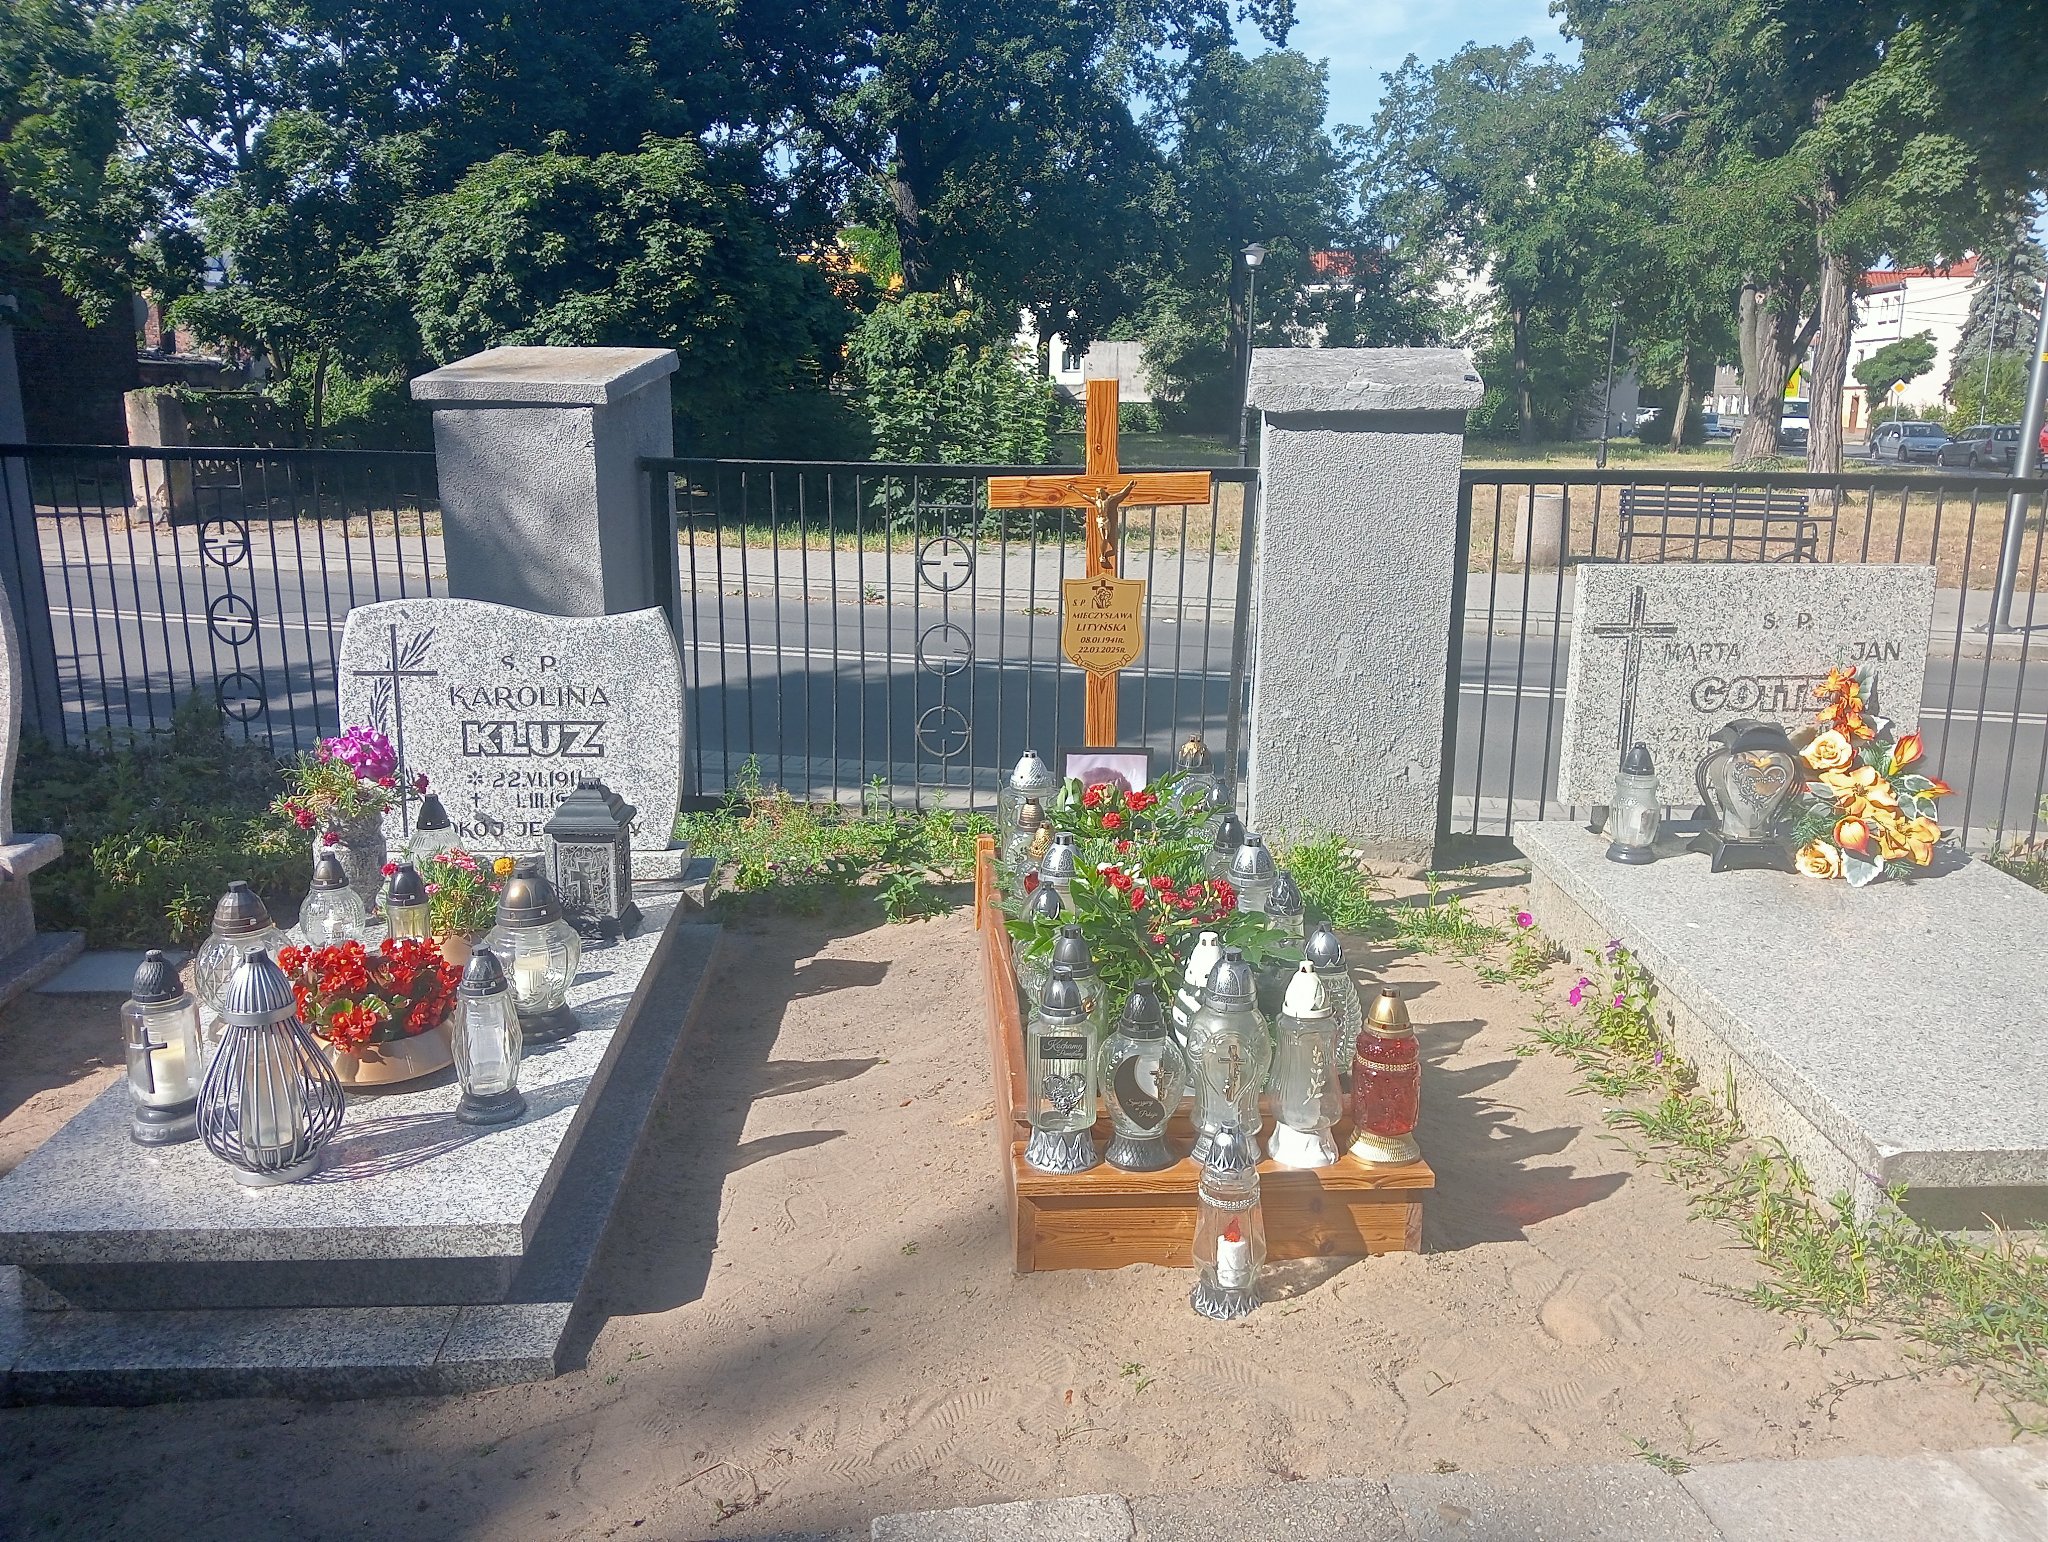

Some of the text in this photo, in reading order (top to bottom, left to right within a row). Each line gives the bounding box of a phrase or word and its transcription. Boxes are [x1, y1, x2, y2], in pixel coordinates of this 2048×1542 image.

[1076, 621, 1127, 632] LITYŃSKA
[1663, 641, 1901, 662] MARTA JAN
[449, 685, 610, 712] KAROLINA
[461, 720, 606, 758] KLUZ
[515, 821, 544, 837] JE
[1043, 1039, 1084, 1052] Kochamy
